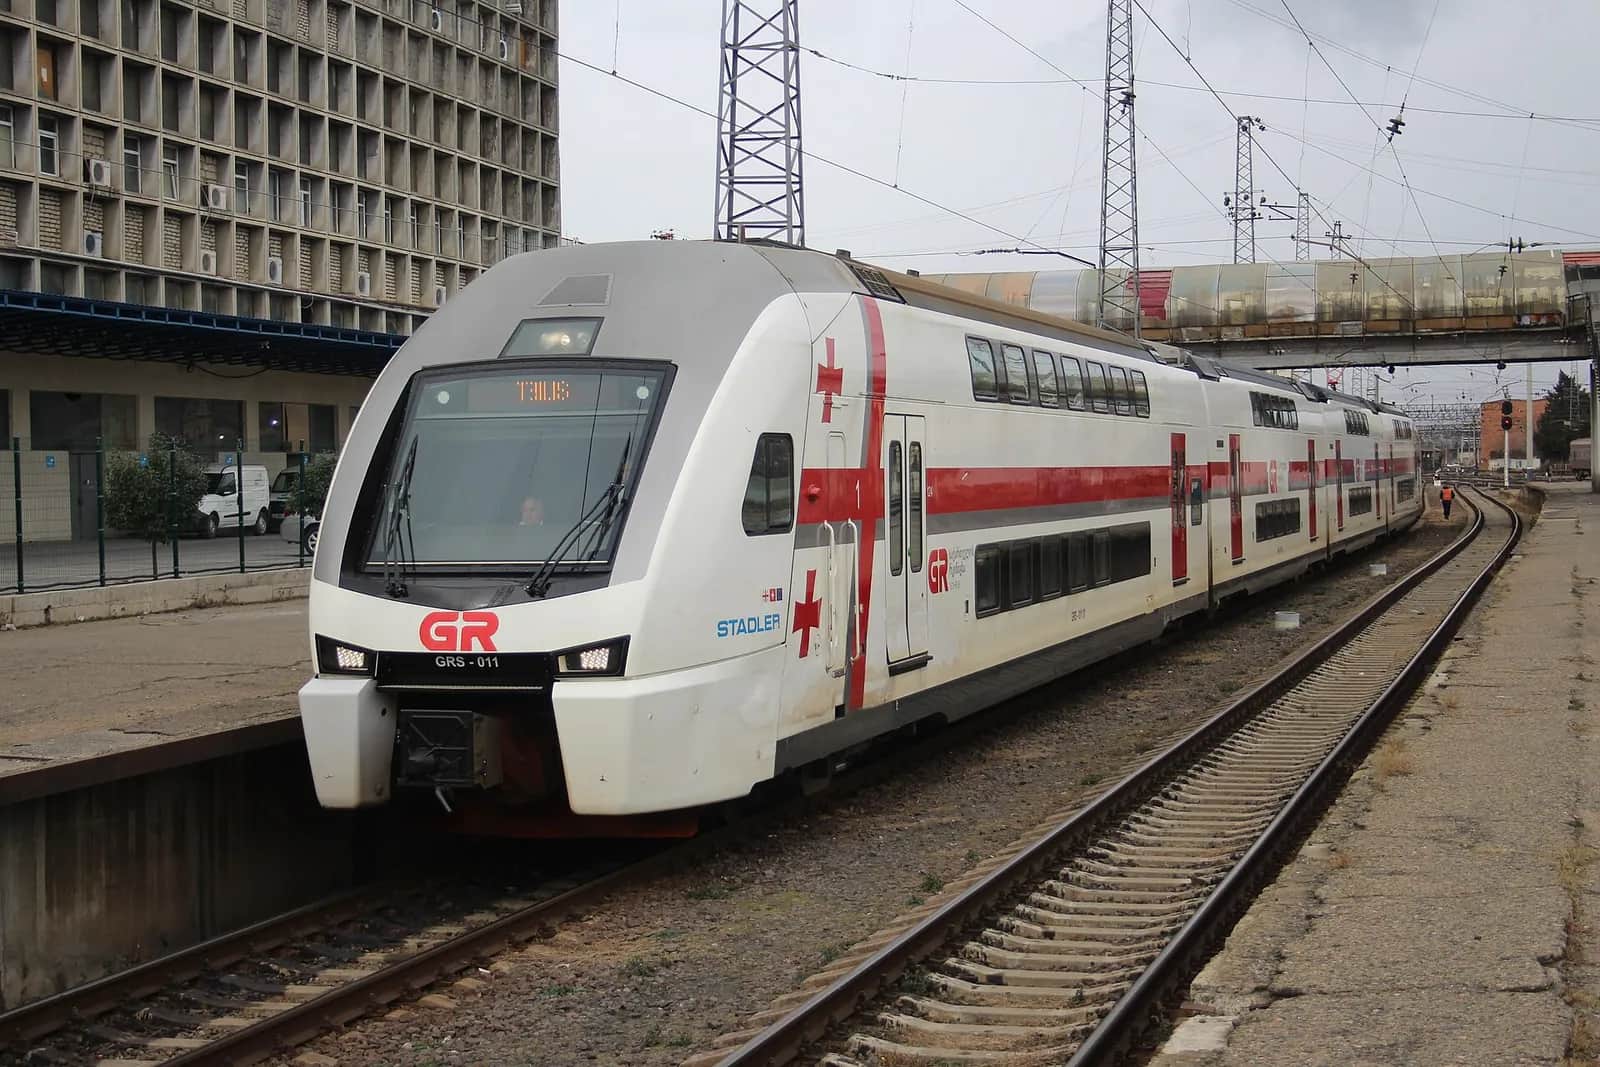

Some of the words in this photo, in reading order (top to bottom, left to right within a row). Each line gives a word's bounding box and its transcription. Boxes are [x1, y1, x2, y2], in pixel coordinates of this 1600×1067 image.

[928, 548, 949, 594] GR
[419, 611, 499, 652] GR
[717, 613, 781, 637] STADLER
[435, 656, 465, 668] GRS
[477, 656, 499, 668] 011
